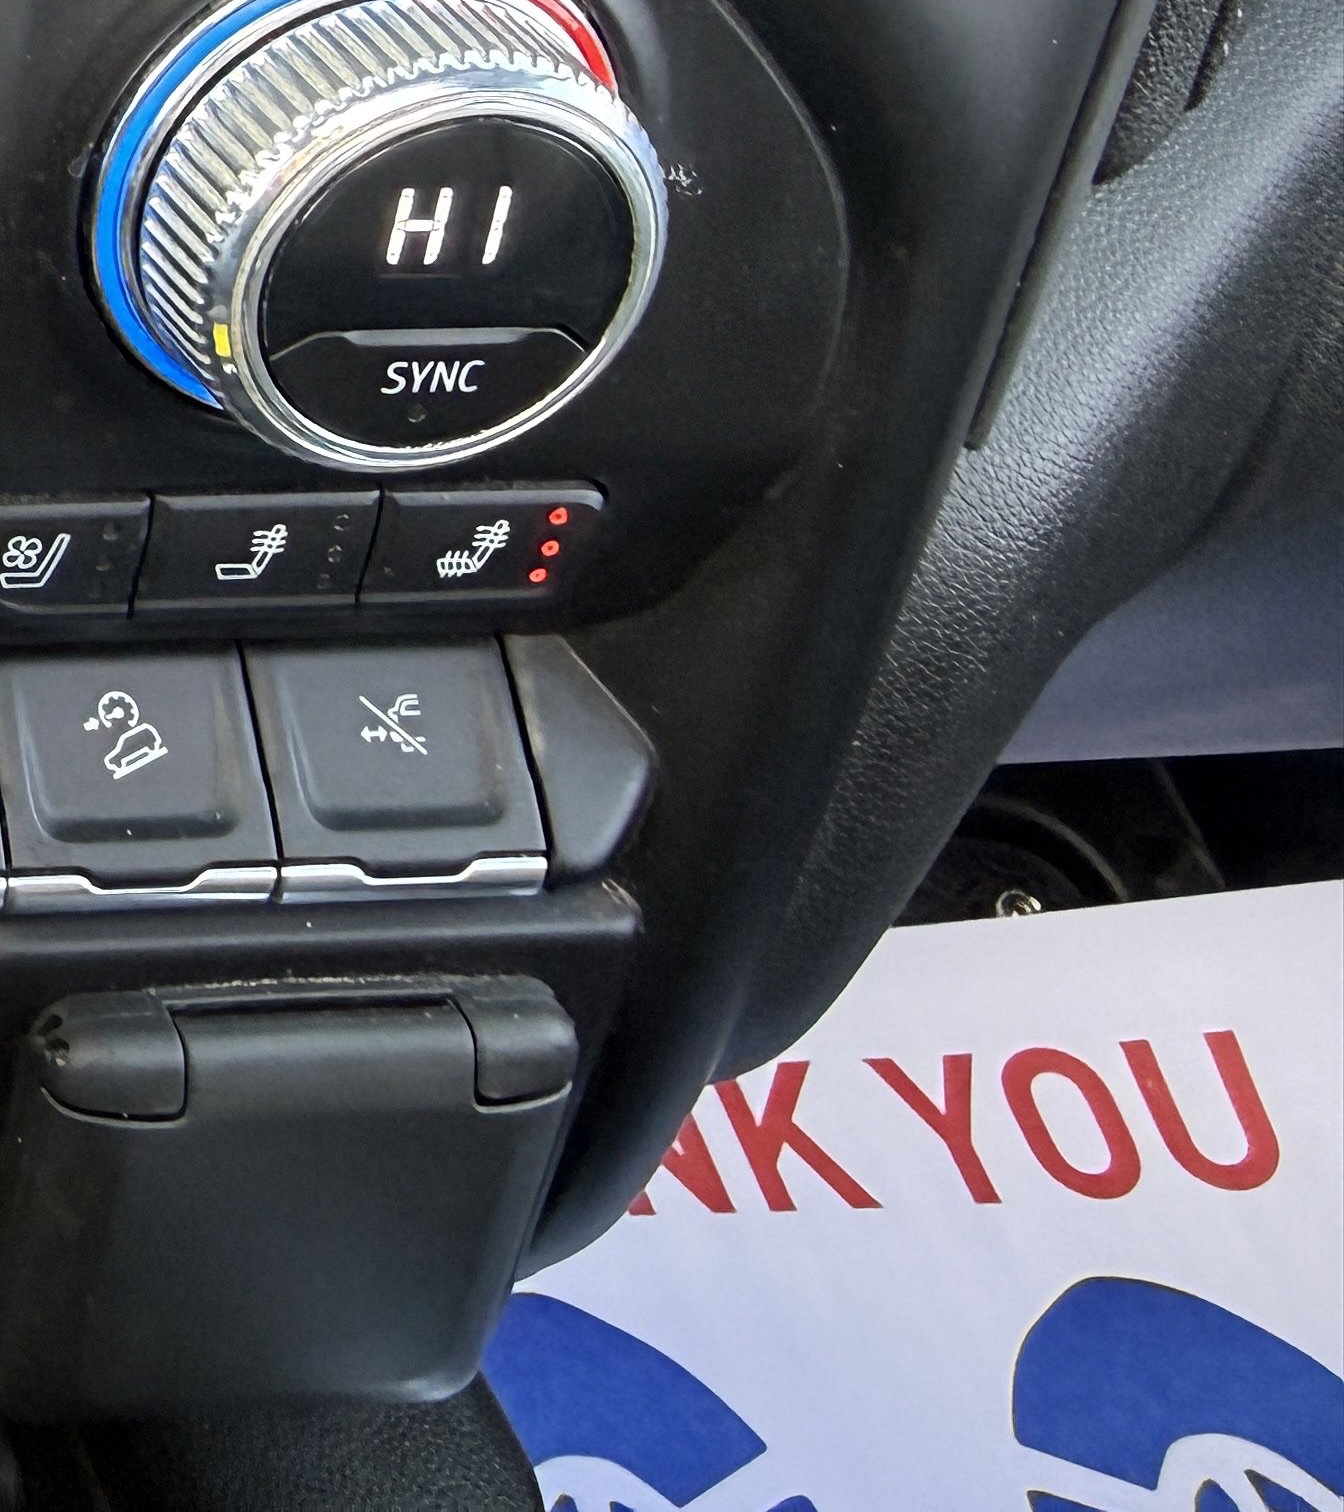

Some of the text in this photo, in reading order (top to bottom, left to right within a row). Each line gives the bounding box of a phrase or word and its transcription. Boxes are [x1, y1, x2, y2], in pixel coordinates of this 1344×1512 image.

[386, 186, 513, 266] HI
[381, 359, 486, 395] SYNC
[868, 1031, 1280, 1204] YOU
